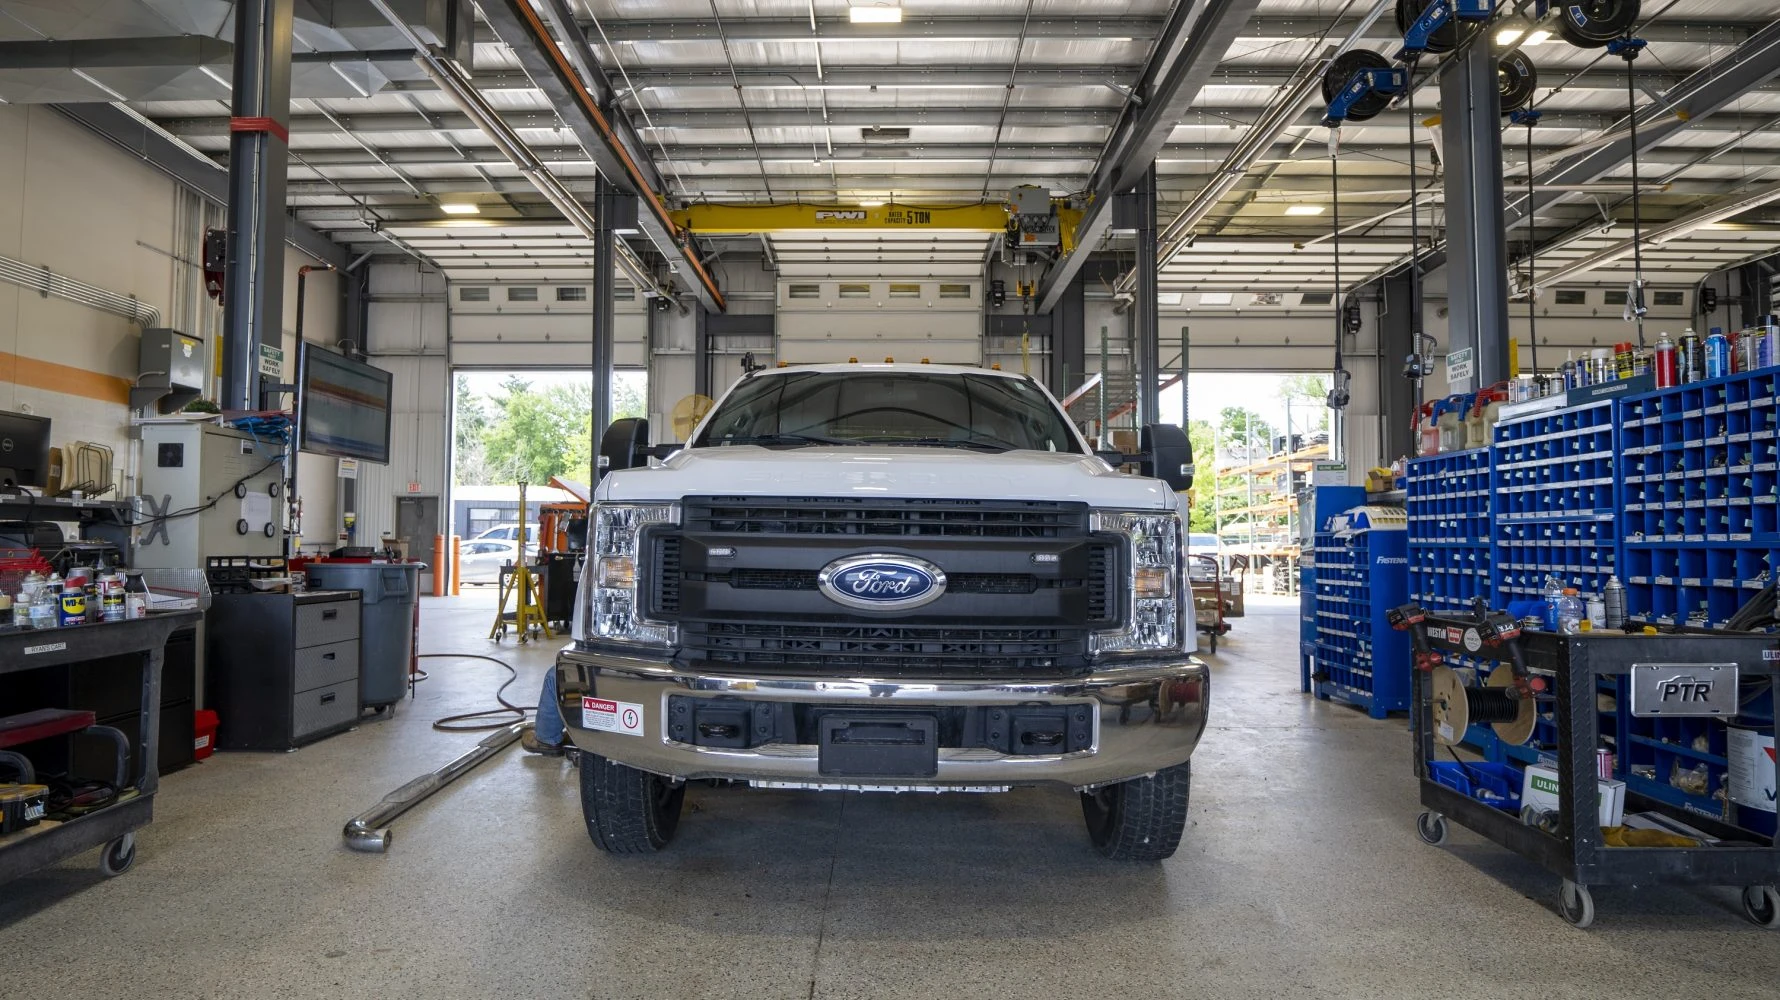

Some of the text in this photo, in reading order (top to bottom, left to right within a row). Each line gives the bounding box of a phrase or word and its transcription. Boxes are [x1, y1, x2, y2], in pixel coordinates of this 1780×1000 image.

[816, 210, 867, 219] PWI
[906, 210, 931, 225] 5 TON
[263, 346, 281, 356] SAFETY
[1450, 351, 1468, 361] SAFETY
[264, 359, 280, 367] WORK
[1451, 362, 1468, 372] WORK
[262, 365, 281, 375] SAFELY
[1450, 370, 1469, 380] SAFELY
[409, 483, 419, 491] EXIT
[852, 568, 912, 594] Ford
[1660, 682, 1711, 702] PTR
[591, 701, 615, 712] DANGER
